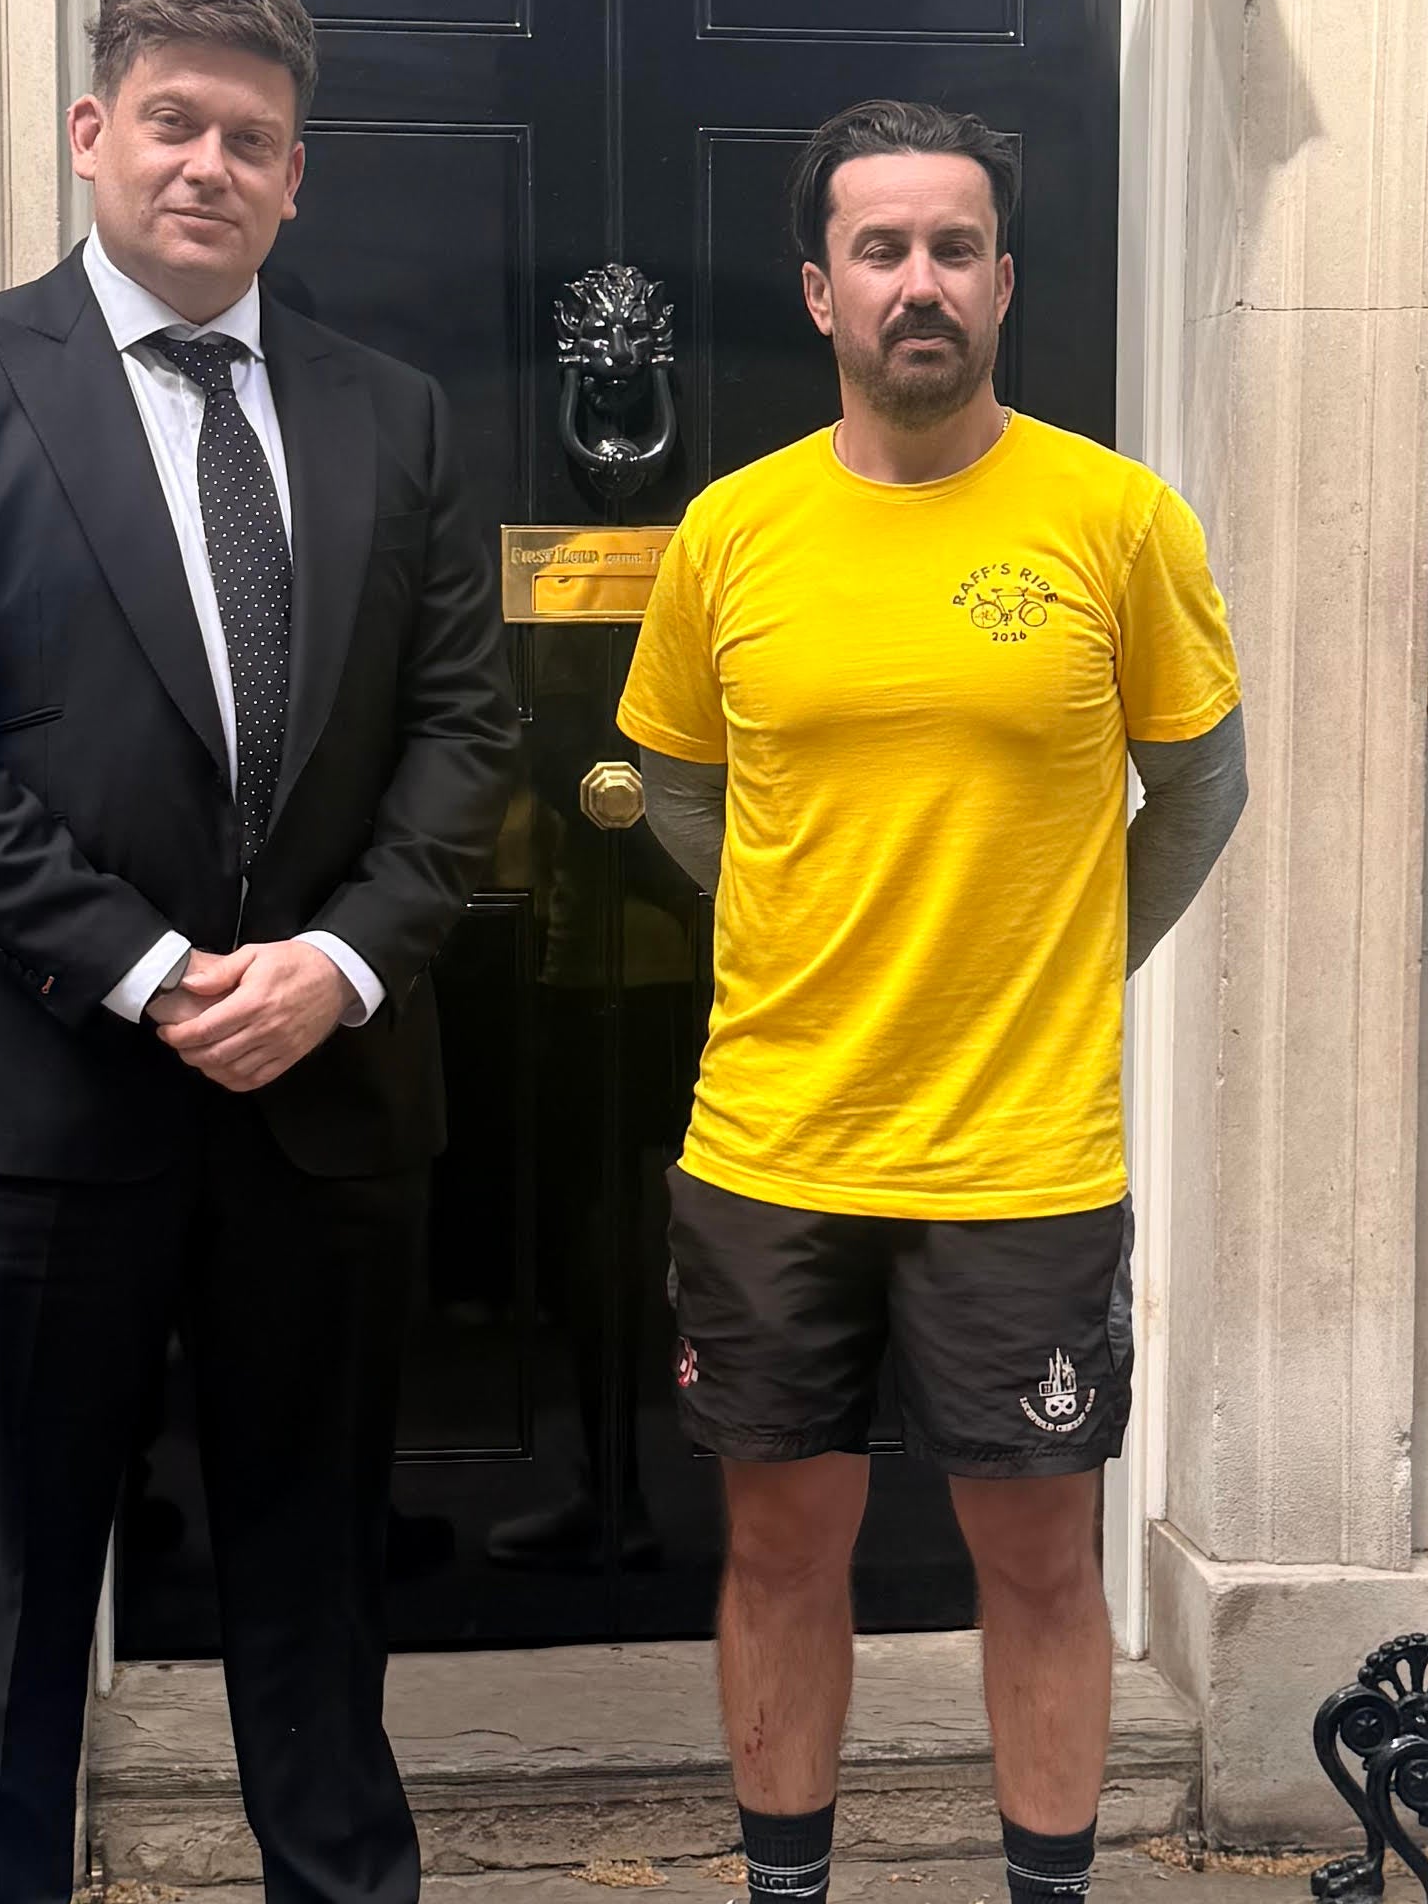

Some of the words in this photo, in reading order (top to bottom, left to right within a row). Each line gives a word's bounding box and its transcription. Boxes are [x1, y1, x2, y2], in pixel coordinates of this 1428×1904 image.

[952, 563, 1011, 606] RAFF'S
[1020, 567, 1058, 603] RIDE
[992, 630, 1027, 642] 2026
